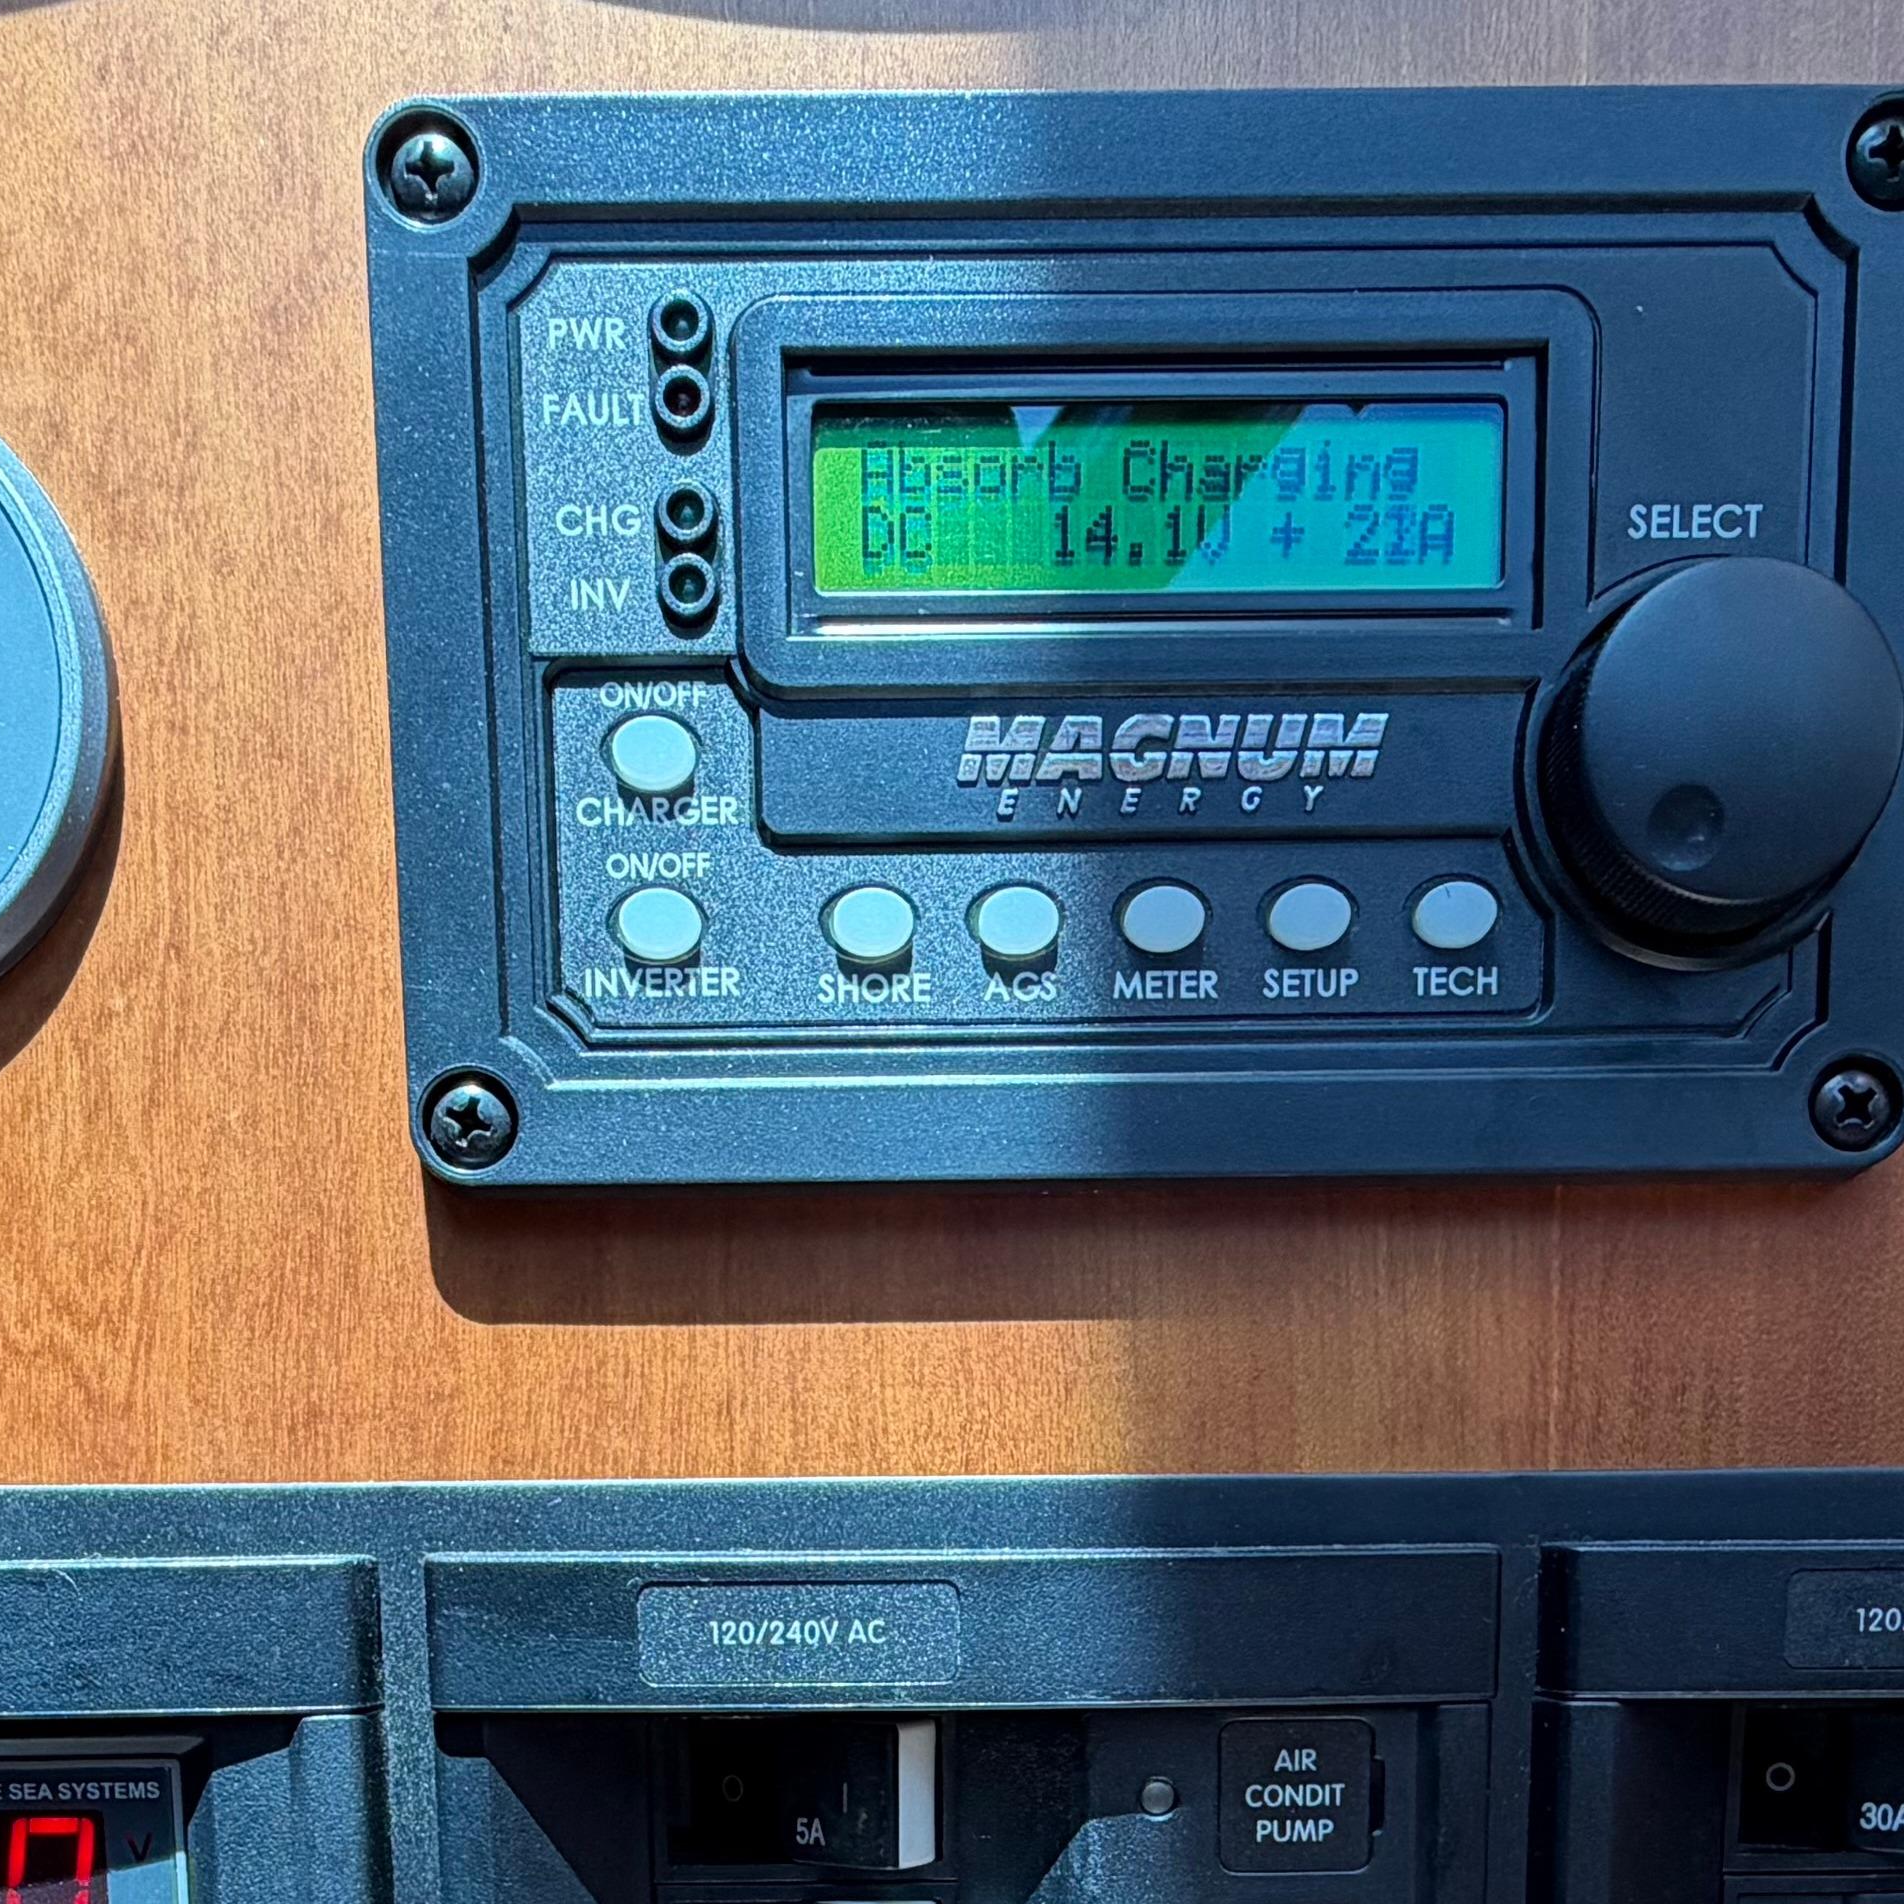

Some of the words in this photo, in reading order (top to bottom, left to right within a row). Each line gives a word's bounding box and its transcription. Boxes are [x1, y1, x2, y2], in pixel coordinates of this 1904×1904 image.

[548, 319, 626, 349] PWR
[543, 396, 644, 427] FAULT
[861, 440, 1083, 500] Absorb
[1122, 440, 1420, 501] Charging
[555, 504, 641, 536] CHG
[1627, 503, 1763, 540] SELECT
[861, 506, 933, 562] DC
[1055, 506, 1234, 566] 14.1V
[570, 580, 630, 611] INV
[599, 681, 708, 708] ON/OFF
[958, 713, 1389, 783] MAGNUM
[576, 798, 739, 828] CHARGER
[997, 786, 1324, 817] ENERGY
[605, 852, 711, 880] ON/OFF
[584, 967, 741, 999] INVERTER
[817, 972, 932, 1004] SHORE
[983, 973, 1059, 1002] AGS
[1112, 970, 1219, 1000] METER
[1262, 967, 1359, 999] SETUP
[1412, 966, 1499, 997] TECH
[708, 1619, 839, 1646] 120/240V
[847, 1619, 887, 1645] AC
[1273, 1748, 1318, 1772] AIR
[8, 1783, 53, 1801] SEA
[58, 1781, 161, 1801] SYSTEMS
[1245, 1783, 1346, 1808] CONDIT
[795, 1817, 826, 1847] 5A
[1255, 1819, 1335, 1843] PUMP
[126, 1832, 153, 1862] V
